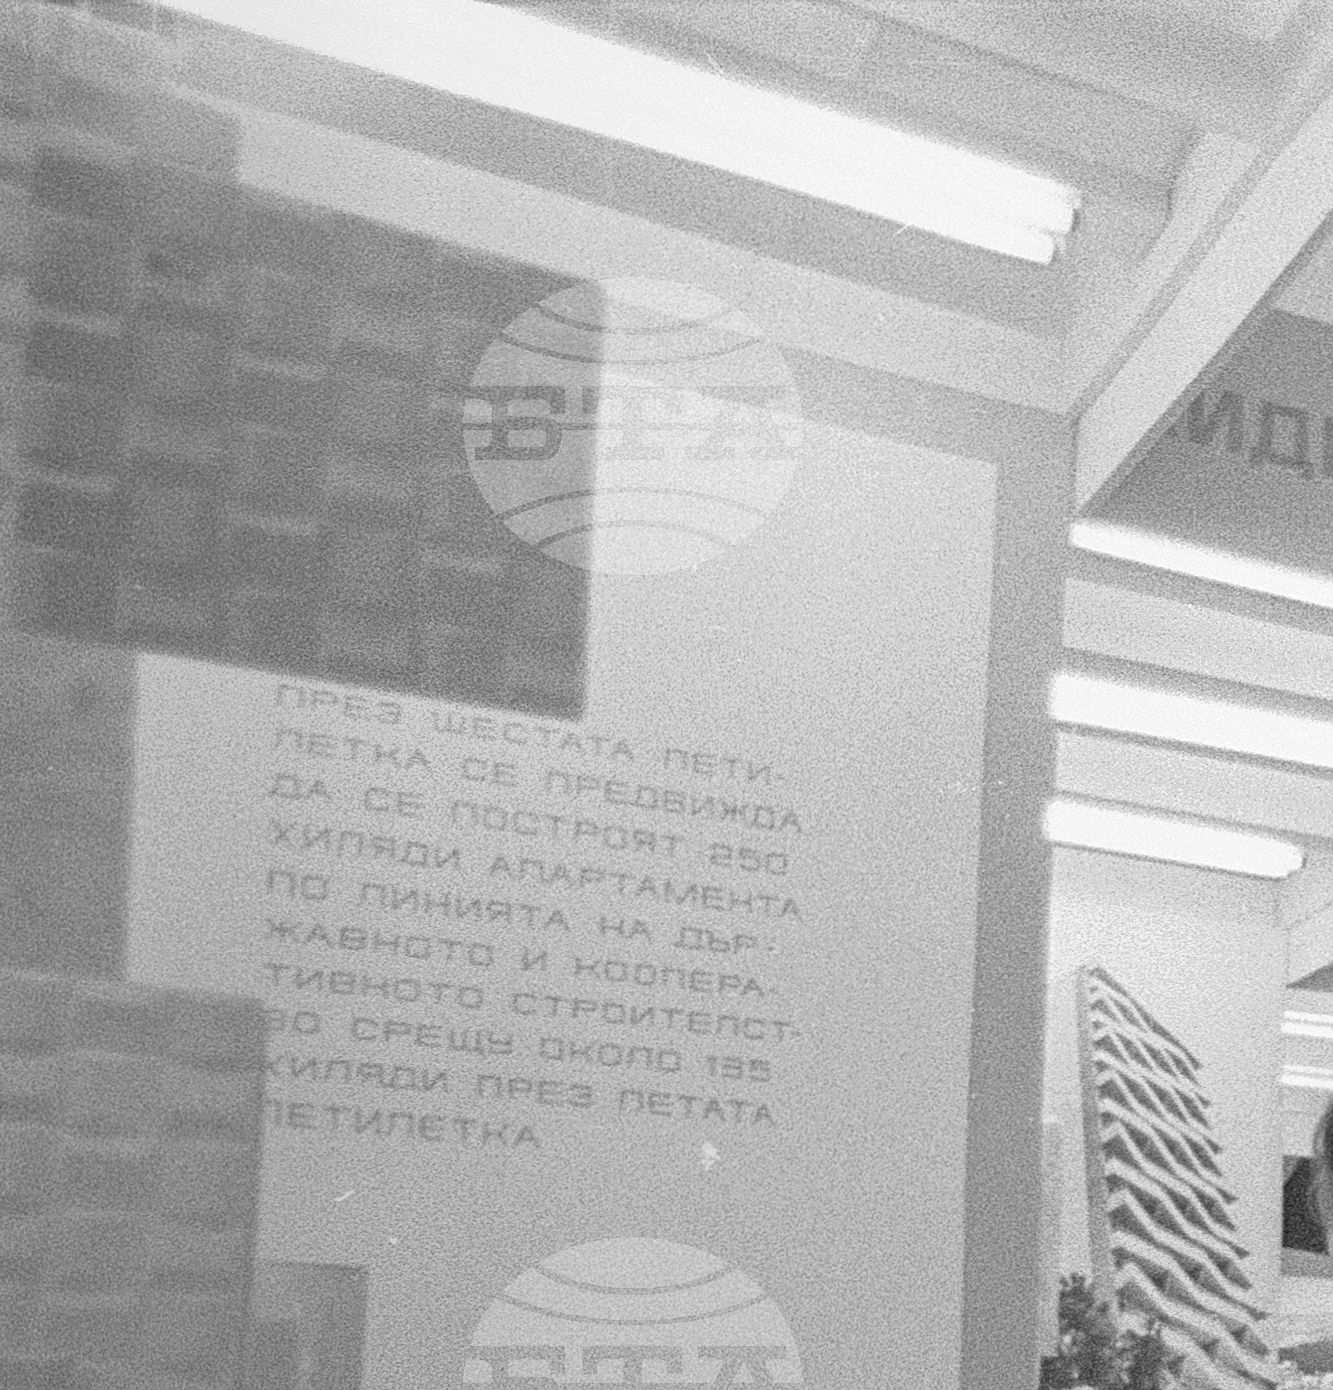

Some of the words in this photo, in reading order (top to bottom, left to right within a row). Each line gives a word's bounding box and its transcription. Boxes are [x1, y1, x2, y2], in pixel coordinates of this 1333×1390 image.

[274, 683, 402, 726] ПРЕЗ
[432, 711, 634, 761] ШЕСТАТА
[268, 771, 331, 803] ДА
[363, 786, 424, 818] СЕ
[450, 799, 684, 857] ПОСТРОЯТ
[708, 843, 789, 876] 250
[461, 757, 517, 787] СЕ
[545, 770, 803, 835] ПРЕДВИЖДА
[270, 819, 462, 871] ХИЛЯДИ
[491, 855, 801, 917] АПАРТАМЕНТА
[267, 870, 329, 901] ПО
[361, 883, 570, 932] ЛИНИЯТА
[600, 917, 652, 940] НА
[266, 918, 494, 968] ЖАВНОТО
[521, 950, 548, 972] И
[266, 962, 484, 1012] ТИВНОТО
[352, 1017, 514, 1056] СРЕЩУ
[539, 1035, 681, 1073] ОКОЛО
[477, 1072, 594, 1107] ПРЕЗ
[620, 1087, 776, 1128] ПЕТАТА
